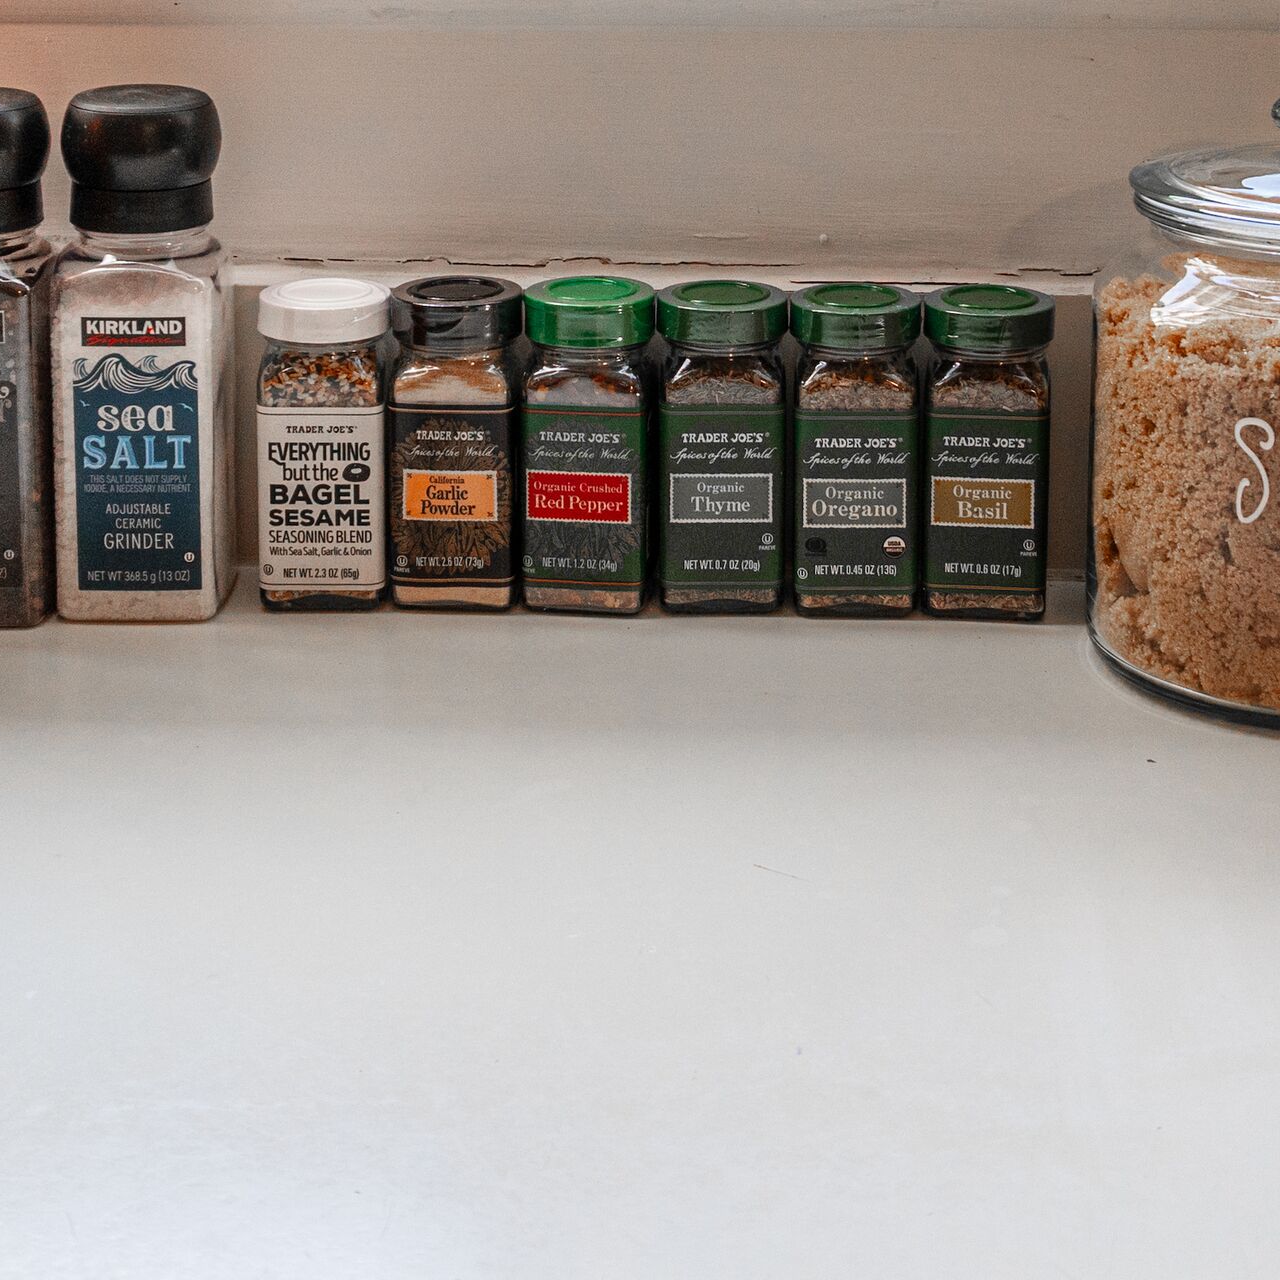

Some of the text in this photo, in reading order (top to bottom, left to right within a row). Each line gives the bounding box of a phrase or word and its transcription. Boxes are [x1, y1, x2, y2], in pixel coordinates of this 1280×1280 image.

[86, 320, 183, 335] KIRKLAND
[96, 404, 176, 432] sea
[286, 425, 324, 434] TRADER
[416, 430, 452, 440] TRADER
[540, 431, 586, 442] TRADER
[681, 432, 728, 443] TRADER
[814, 437, 862, 448] TRADER
[942, 436, 990, 448] TRADER
[83, 434, 192, 470] SALT
[268, 442, 371, 461] EVERYTHING
[465, 445, 499, 457] World
[528, 445, 564, 461] Spices
[600, 448, 634, 460] World
[669, 447, 707, 464] Spices
[743, 447, 778, 459] World
[931, 450, 968, 467] Spices
[1005, 452, 1039, 465] World
[803, 452, 840, 469] Spices
[876, 452, 911, 465] World
[90, 474, 105, 483] THIS
[106, 474, 123, 483] SALT
[125, 474, 145, 483] DOES
[147, 474, 159, 483] NOT
[283, 462, 339, 481] but the
[429, 475, 465, 484] California
[533, 480, 623, 494] Organic Crushed
[116, 483, 156, 493] NECESSARY
[269, 484, 370, 505] BAGEL
[426, 484, 469, 500] Garlic
[697, 481, 745, 494] Organic
[825, 486, 884, 502] Organic
[953, 484, 1012, 500] Organic
[106, 503, 171, 515] ADJUSTABLE
[420, 499, 476, 516] Powder
[534, 493, 624, 514] Red Pepper
[690, 496, 751, 515] Thyme
[811, 499, 898, 520] Oregano
[957, 500, 1009, 520] Basil
[115, 517, 162, 529] CERAMIC
[269, 509, 371, 526] SESAME
[103, 532, 175, 550] GRINDER
[269, 530, 372, 543] SEASONING BLEND
[269, 546, 372, 557] With Sea Salt, Garlic & Onion
[415, 556, 427, 566] NET
[442, 556, 452, 566] 2.6
[453, 556, 463, 566] OZ
[465, 556, 484, 569] (73g)
[542, 556, 556, 568] NET
[574, 558, 585, 569] 1.2
[586, 559, 597, 570] OZ
[598, 559, 618, 572] (34g)
[683, 559, 698, 570] NET
[715, 559, 727, 570] 0.7
[729, 559, 740, 570] OZ
[741, 559, 761, 572] (20g)
[814, 564, 829, 575] NET
[846, 564, 863, 575] 0.45
[865, 564, 875, 575] OZ
[944, 562, 959, 573] NET
[975, 563, 988, 574] 0.6
[990, 564, 1000, 575] OZ
[1002, 564, 1022, 578] (17g)
[87, 570, 191, 584] NET WT 368.5 g (13 OZ)
[283, 568, 297, 578] NET
[314, 568, 326, 578] 2.3
[328, 568, 338, 578] OZ
[340, 567, 360, 580] (65g)
